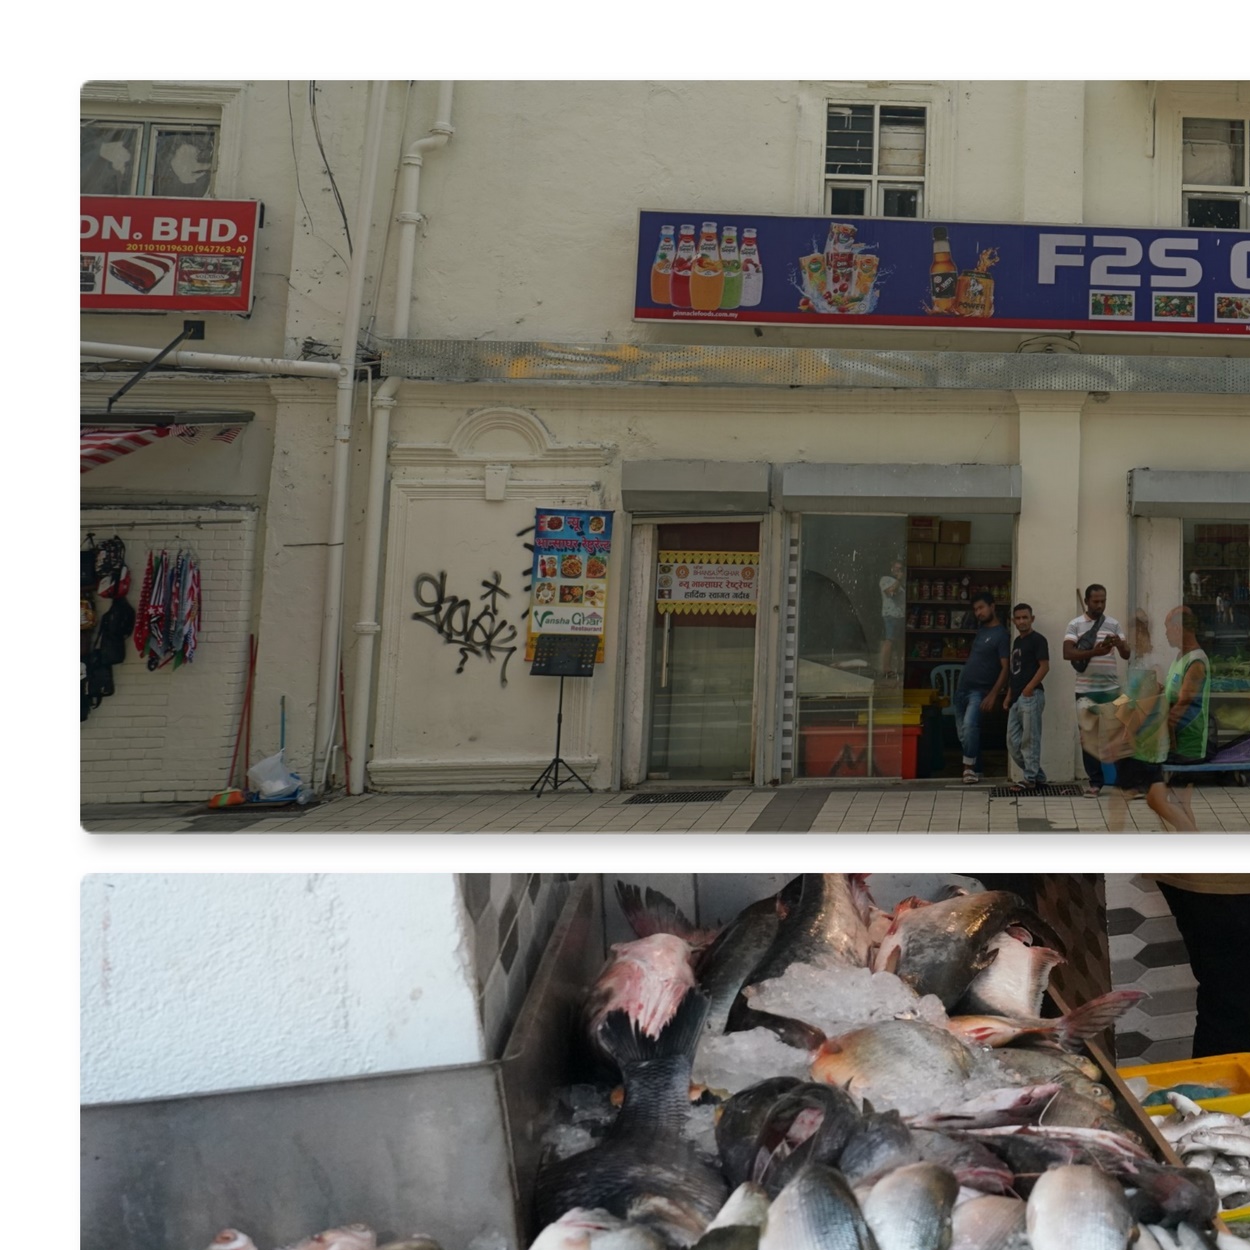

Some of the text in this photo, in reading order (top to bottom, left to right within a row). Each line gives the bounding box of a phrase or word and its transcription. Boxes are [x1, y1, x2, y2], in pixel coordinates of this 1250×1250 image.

[151, 216, 249, 243] BHD.
[126, 243, 247, 255] 201101019630 (947763-A)
[1038, 233, 1203, 288] F2S
[673, 310, 738, 319] pinnaclefoods.com.my
[533, 610, 603, 628] Vansha Ghar
